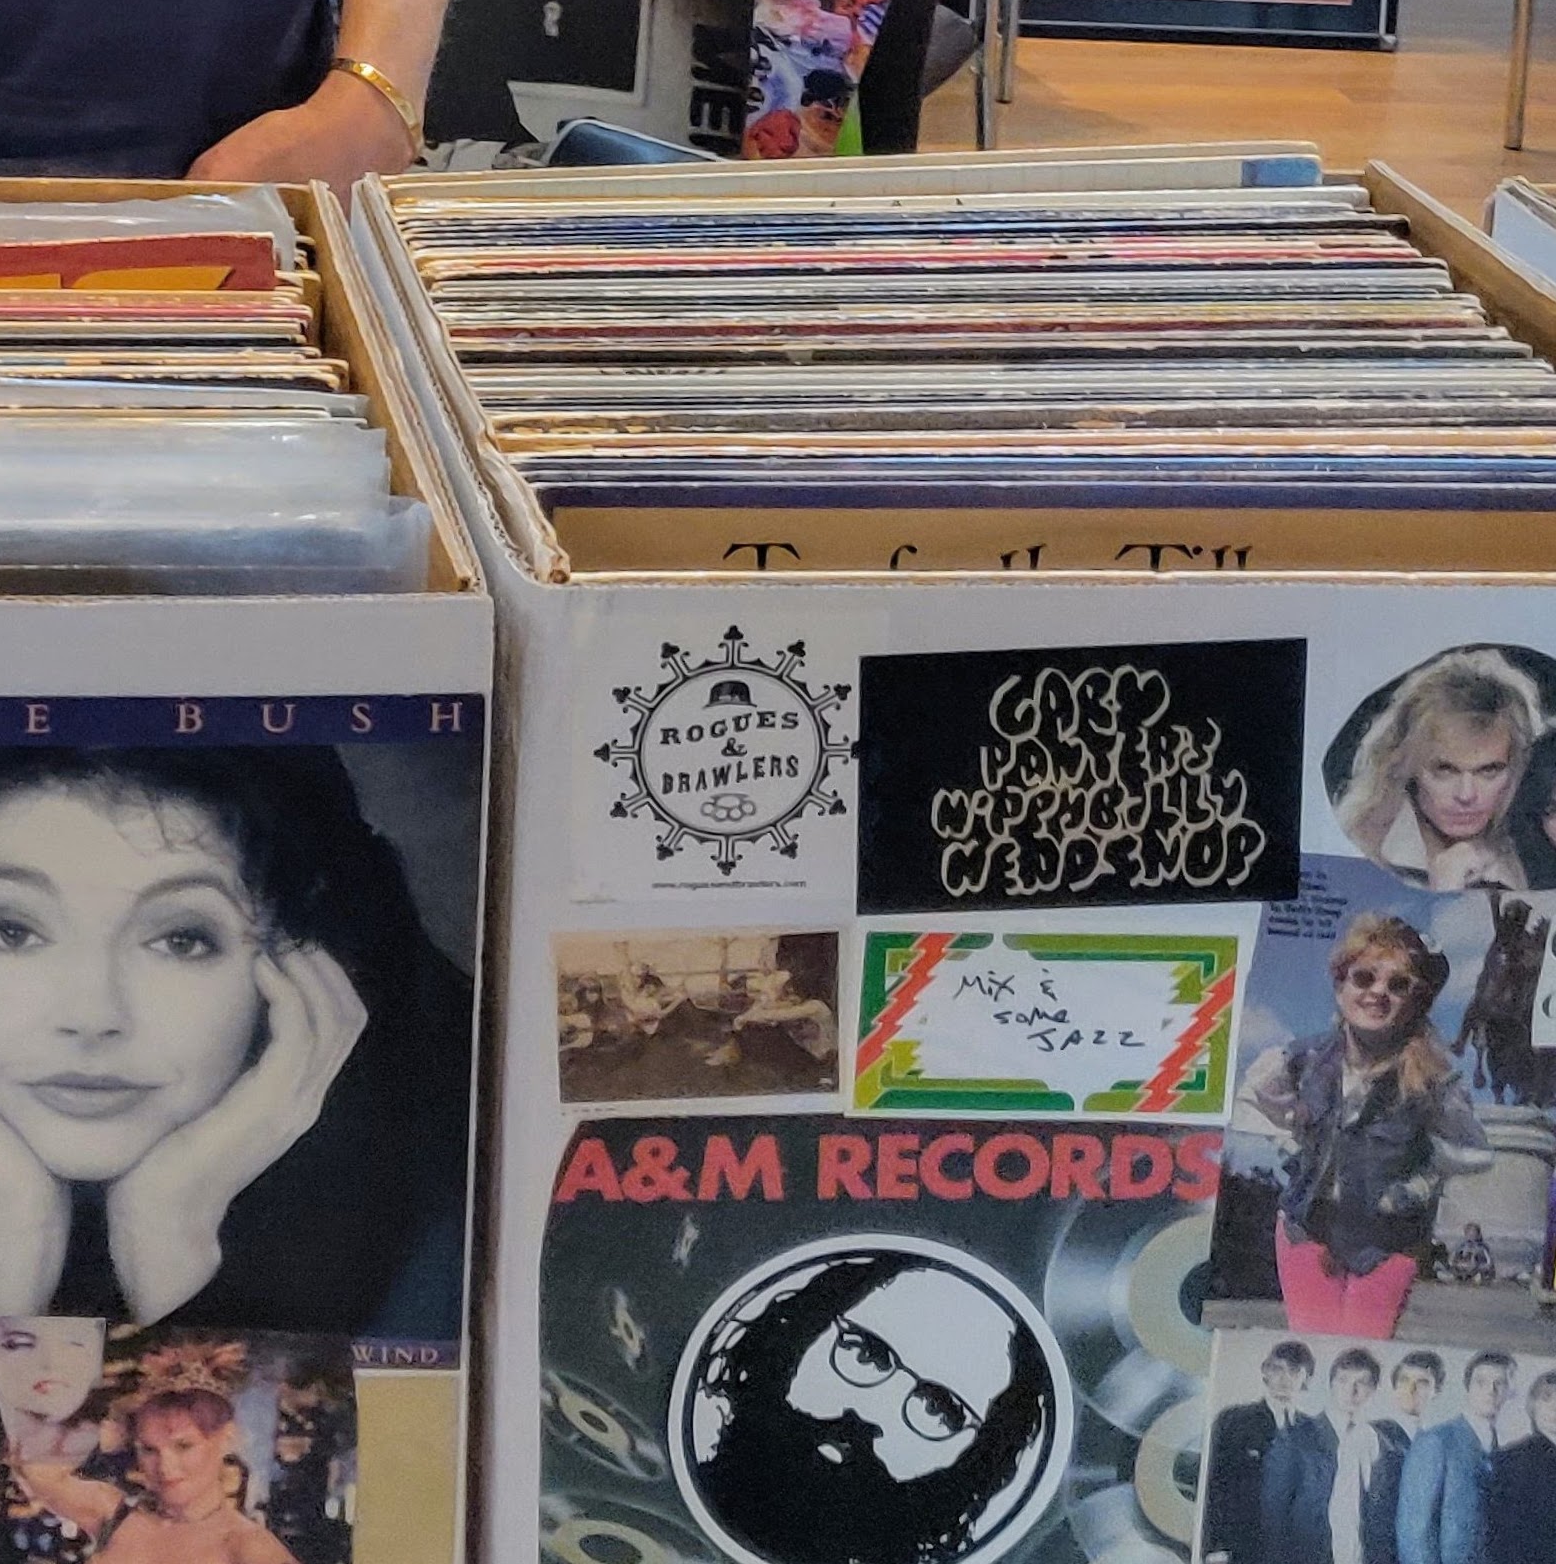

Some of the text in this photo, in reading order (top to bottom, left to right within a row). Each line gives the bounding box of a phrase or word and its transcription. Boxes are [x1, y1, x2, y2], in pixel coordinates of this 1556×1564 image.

[175, 702, 463, 734] BUSH
[660, 711, 800, 745] ROGUES
[720, 737, 748, 757] &
[661, 754, 800, 794] BRAWLERS
[1027, 1027, 1147, 1054] JAZZ
[555, 1132, 1223, 1204] A&M RECORDS
[350, 1344, 439, 1365] WIND
